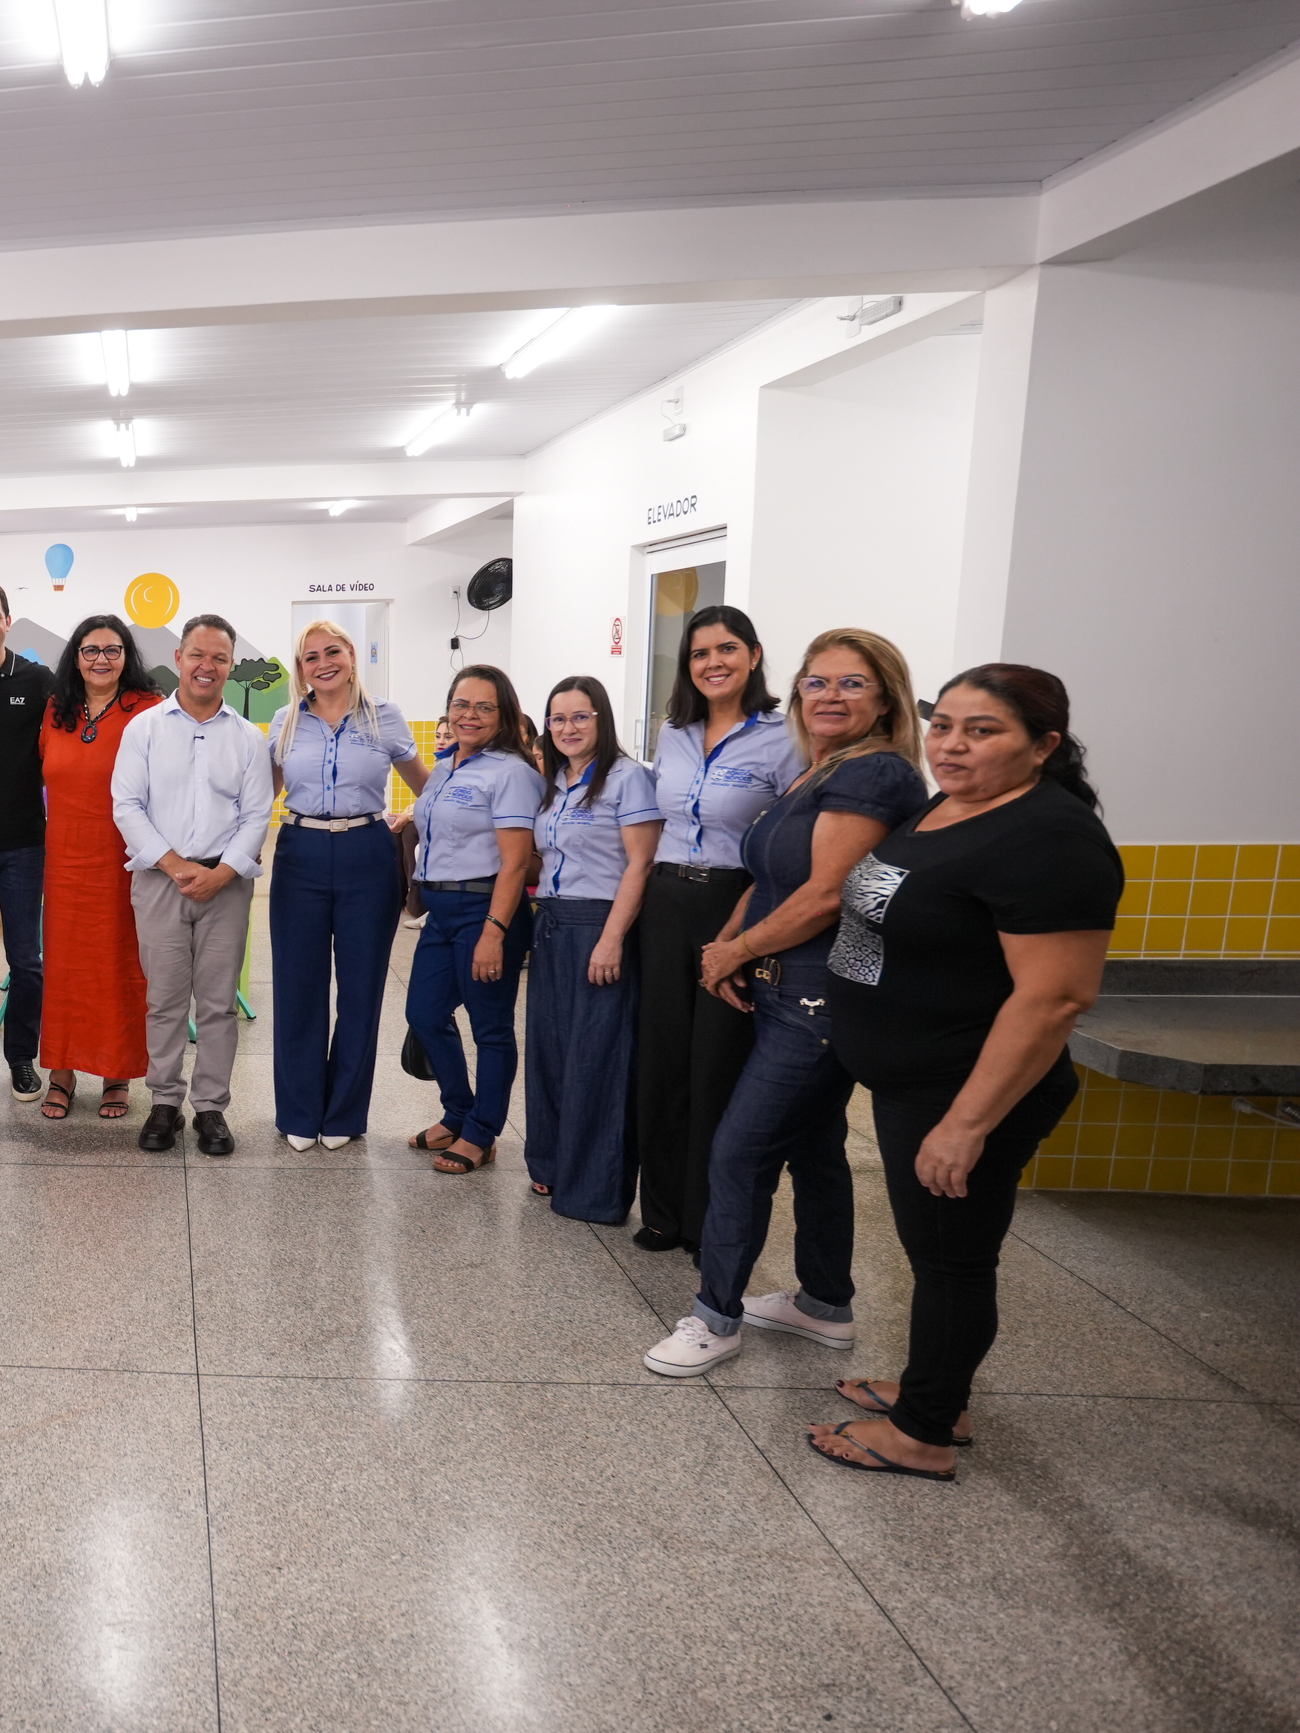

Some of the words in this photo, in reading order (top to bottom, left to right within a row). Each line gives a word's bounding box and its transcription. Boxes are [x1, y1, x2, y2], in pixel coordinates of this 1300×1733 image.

[647, 494, 698, 525] ELEVADOR
[309, 584, 333, 592] SALA
[336, 584, 346, 592] DE
[350, 580, 375, 592] VÍDEO
